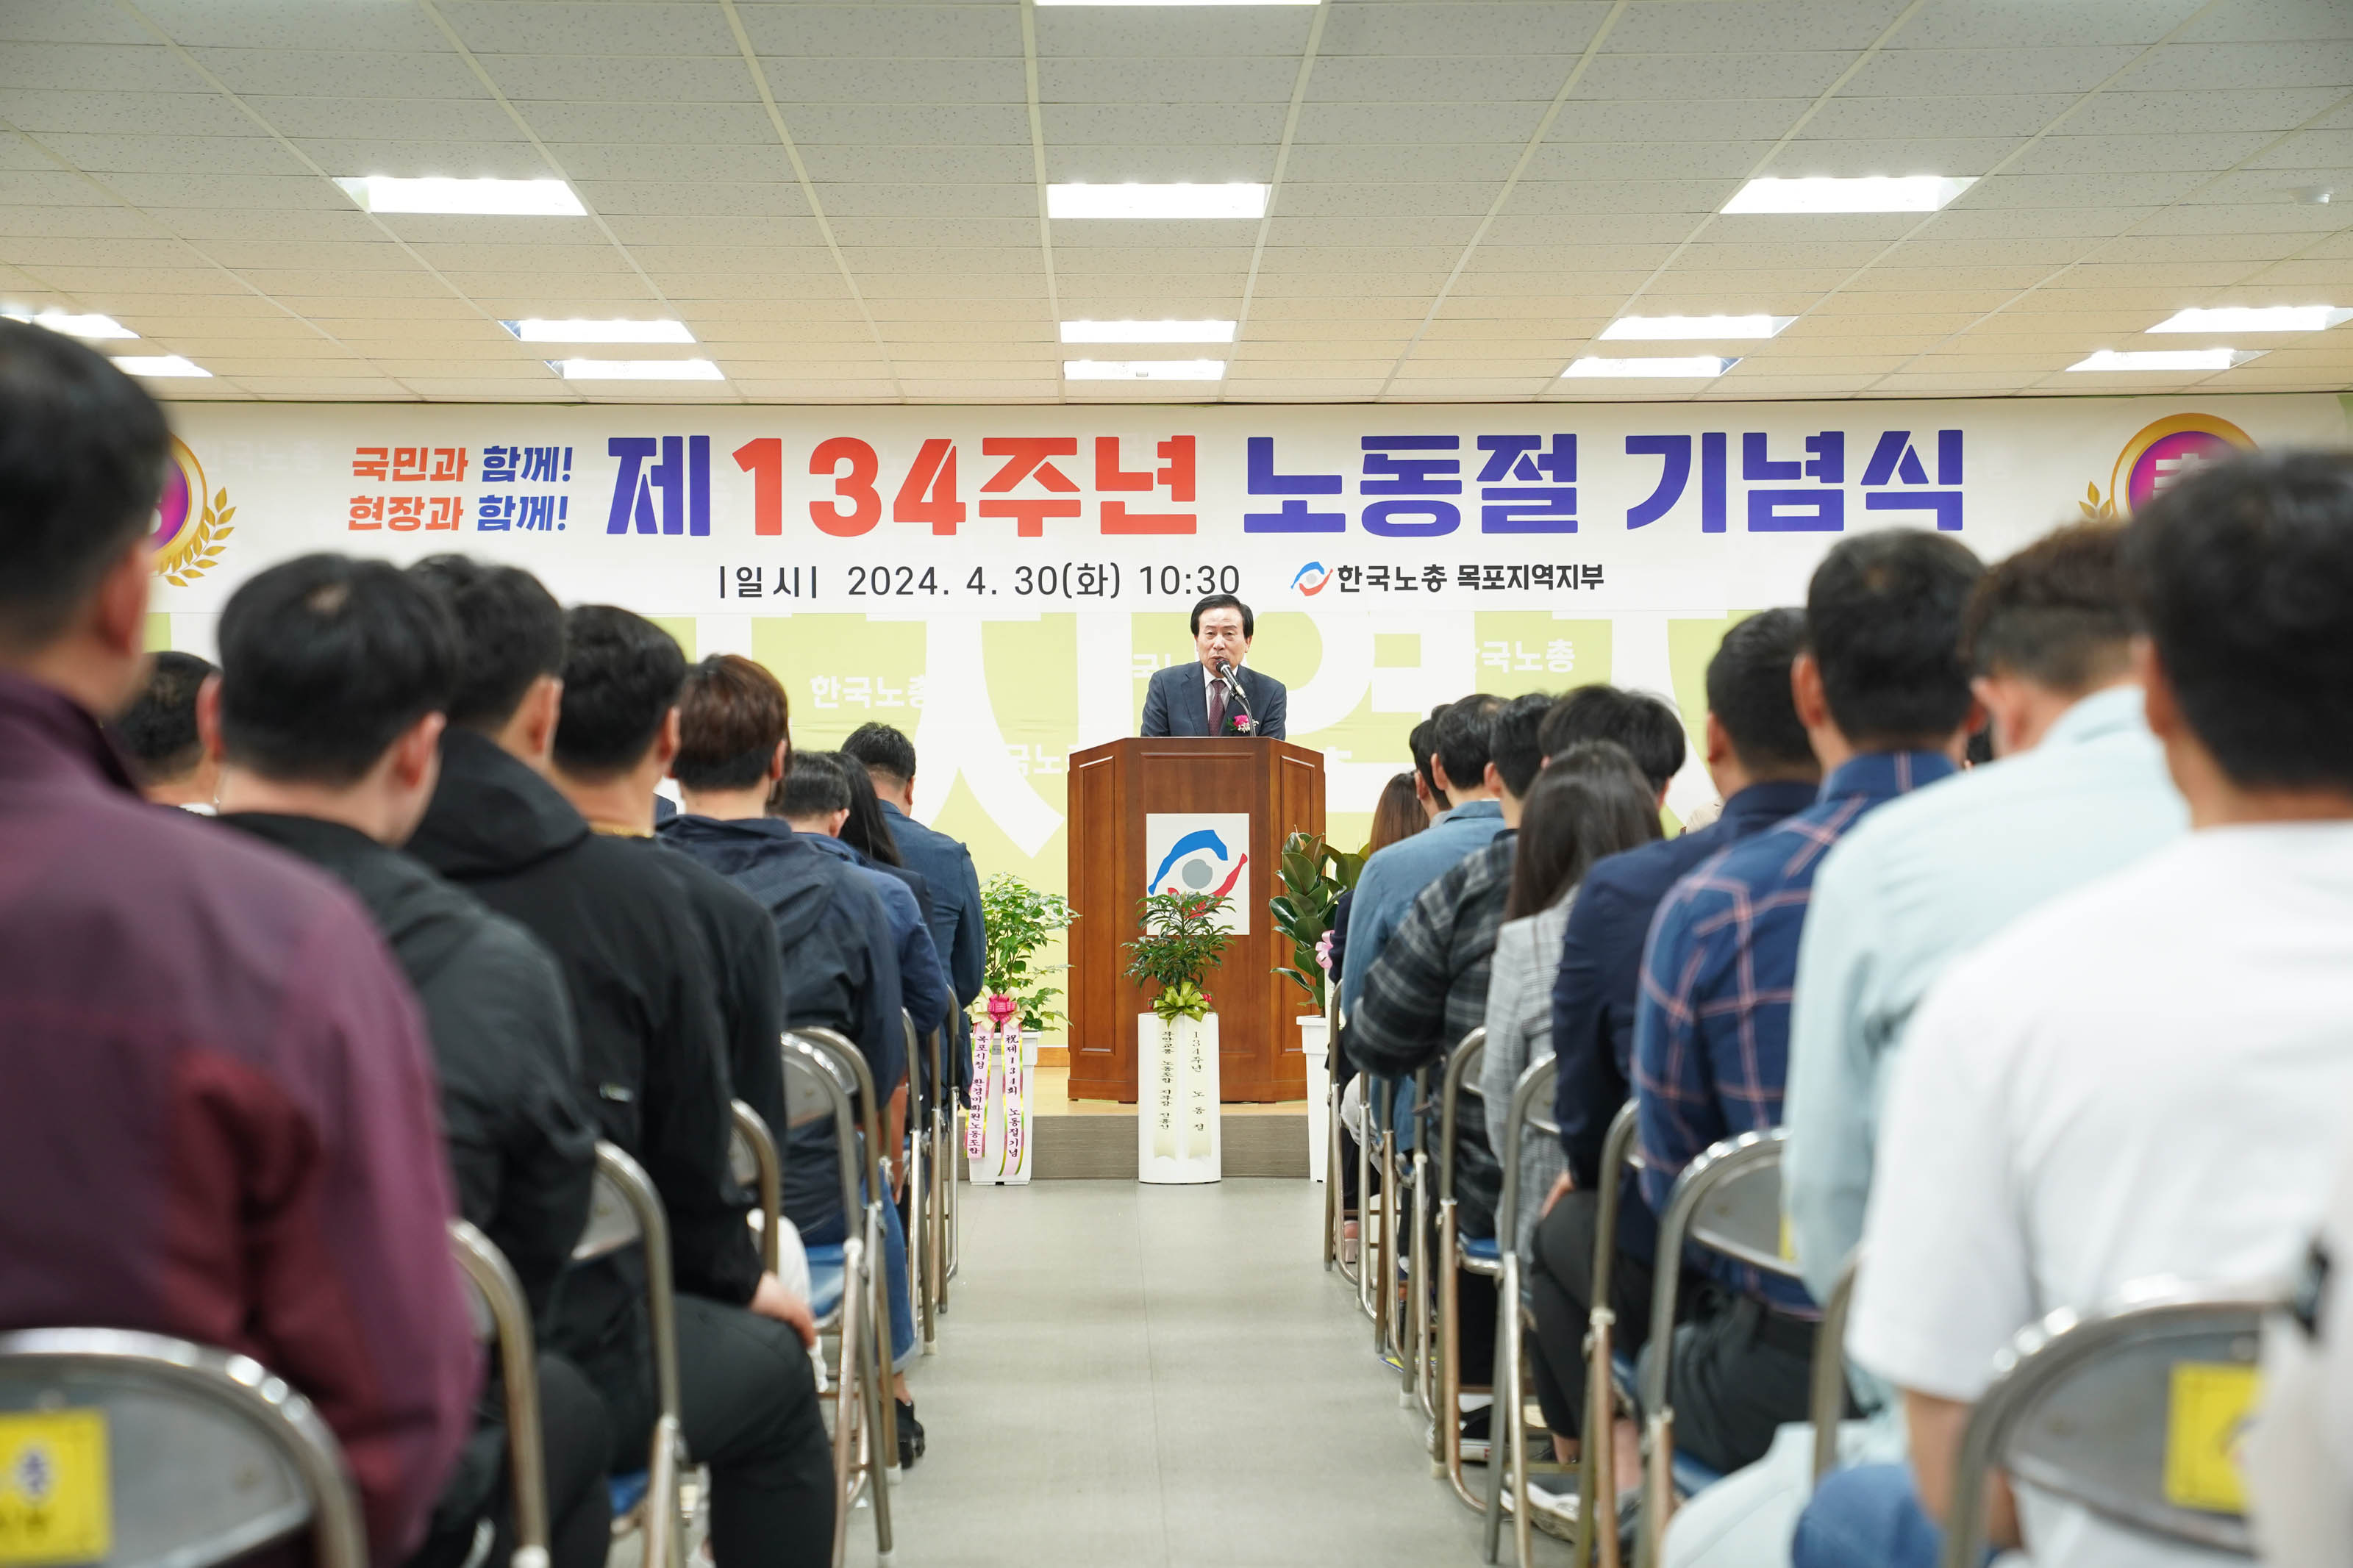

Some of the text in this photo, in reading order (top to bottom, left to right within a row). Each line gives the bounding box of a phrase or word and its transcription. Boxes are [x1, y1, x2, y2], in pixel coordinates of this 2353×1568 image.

[352, 445, 572, 483] 국민과 함께!
[1244, 434, 1578, 537] 노동절
[1626, 429, 1963, 532] 기념식
[349, 495, 568, 531] 현장과 함께!
[848, 566, 949, 595] 2024.
[966, 566, 997, 595] 4.
[1015, 562, 1120, 599] 30(화)
[1140, 565, 1240, 595] 10:30
[1338, 564, 1604, 593] 한국노총 목포지역지부
[1475, 637, 1576, 673] 국노총
